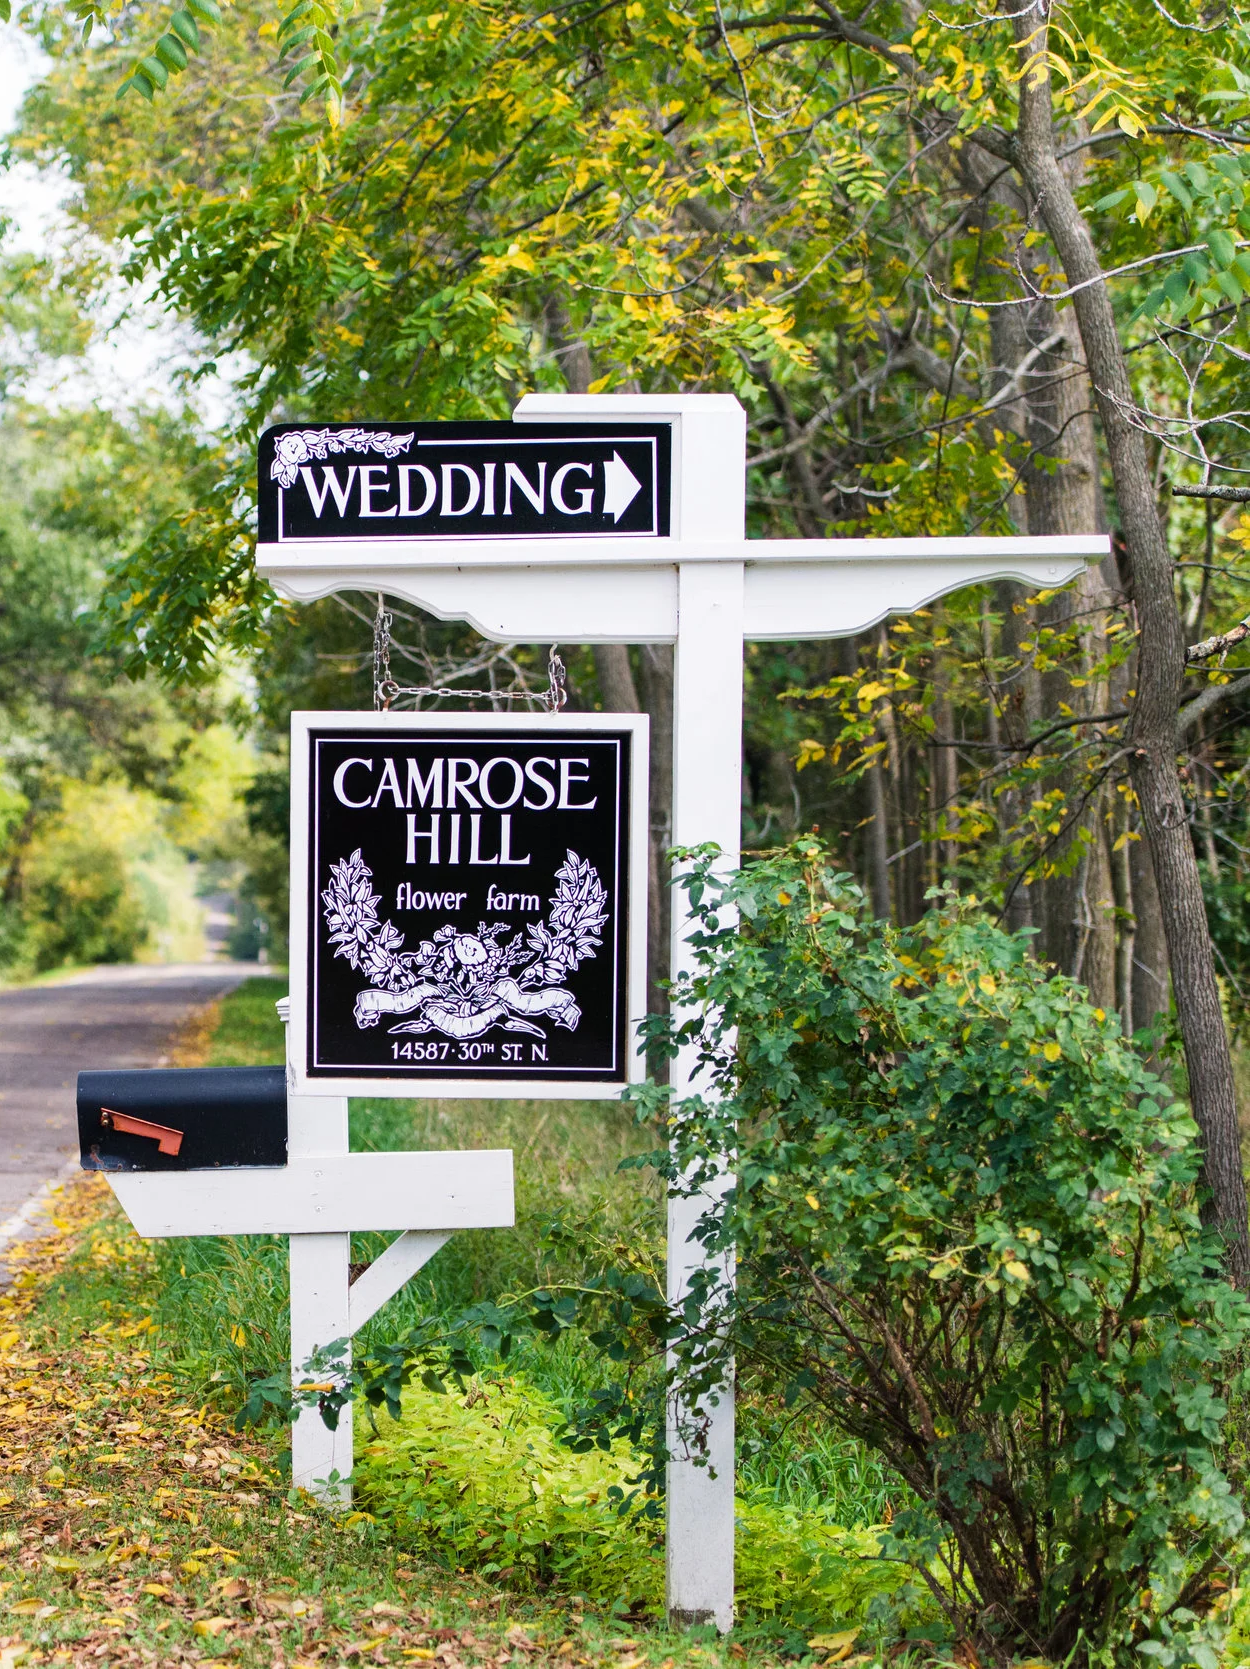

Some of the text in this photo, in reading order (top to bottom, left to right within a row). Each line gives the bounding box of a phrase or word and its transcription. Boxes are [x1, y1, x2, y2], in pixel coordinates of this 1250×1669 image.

[299, 461, 595, 519] WEDDING
[332, 756, 598, 811] CAMROSE
[405, 813, 531, 865] HILL
[395, 882, 540, 911] flower farm
[501, 1043, 523, 1061] ST.
[531, 1043, 549, 1061] N.
